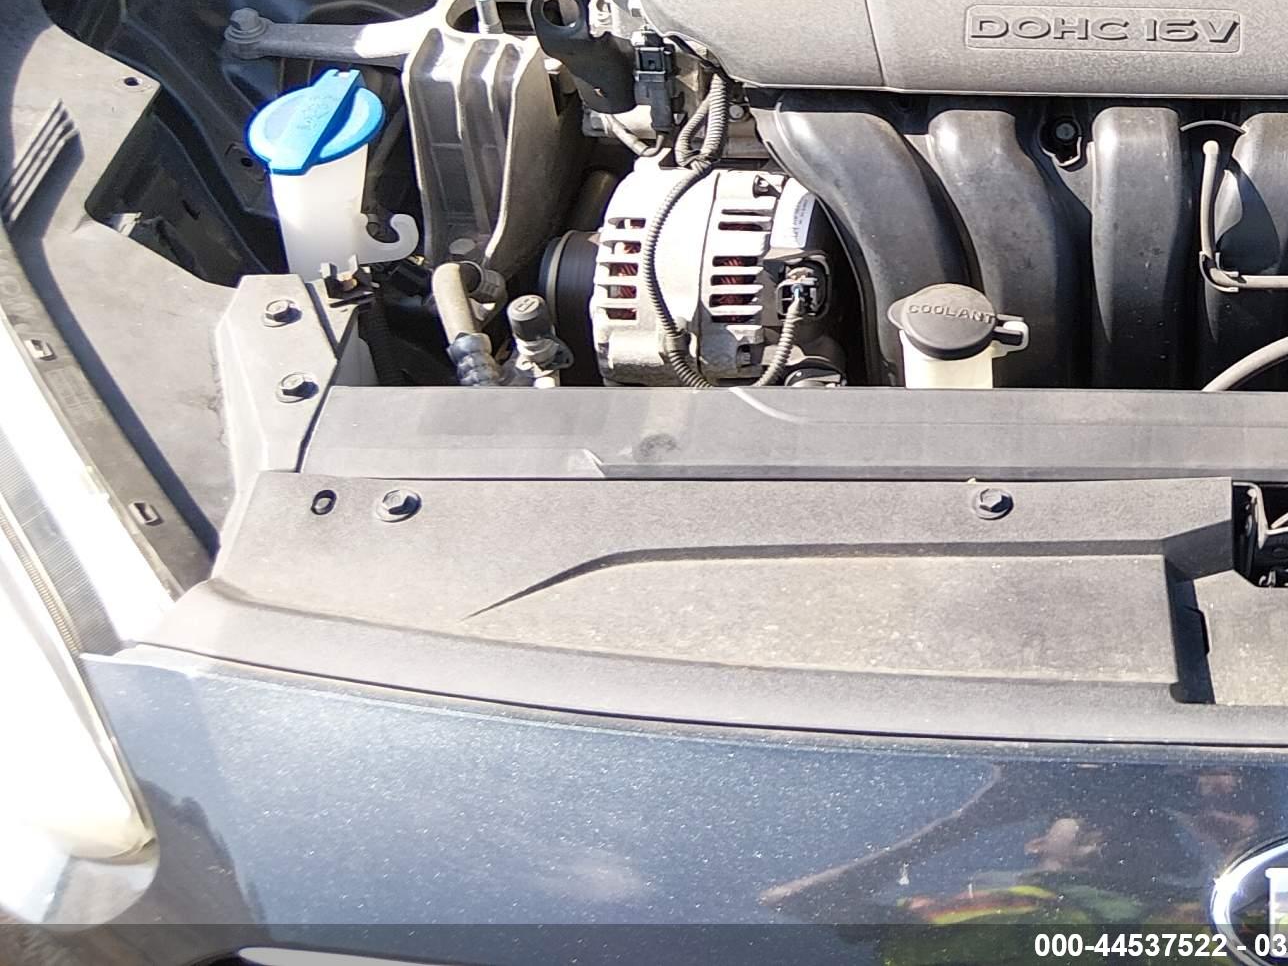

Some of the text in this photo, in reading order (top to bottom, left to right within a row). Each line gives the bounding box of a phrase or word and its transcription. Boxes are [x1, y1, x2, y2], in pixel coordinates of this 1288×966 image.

[970, 14, 1241, 44] DOHC 16V
[906, 304, 998, 325] COOLANT
